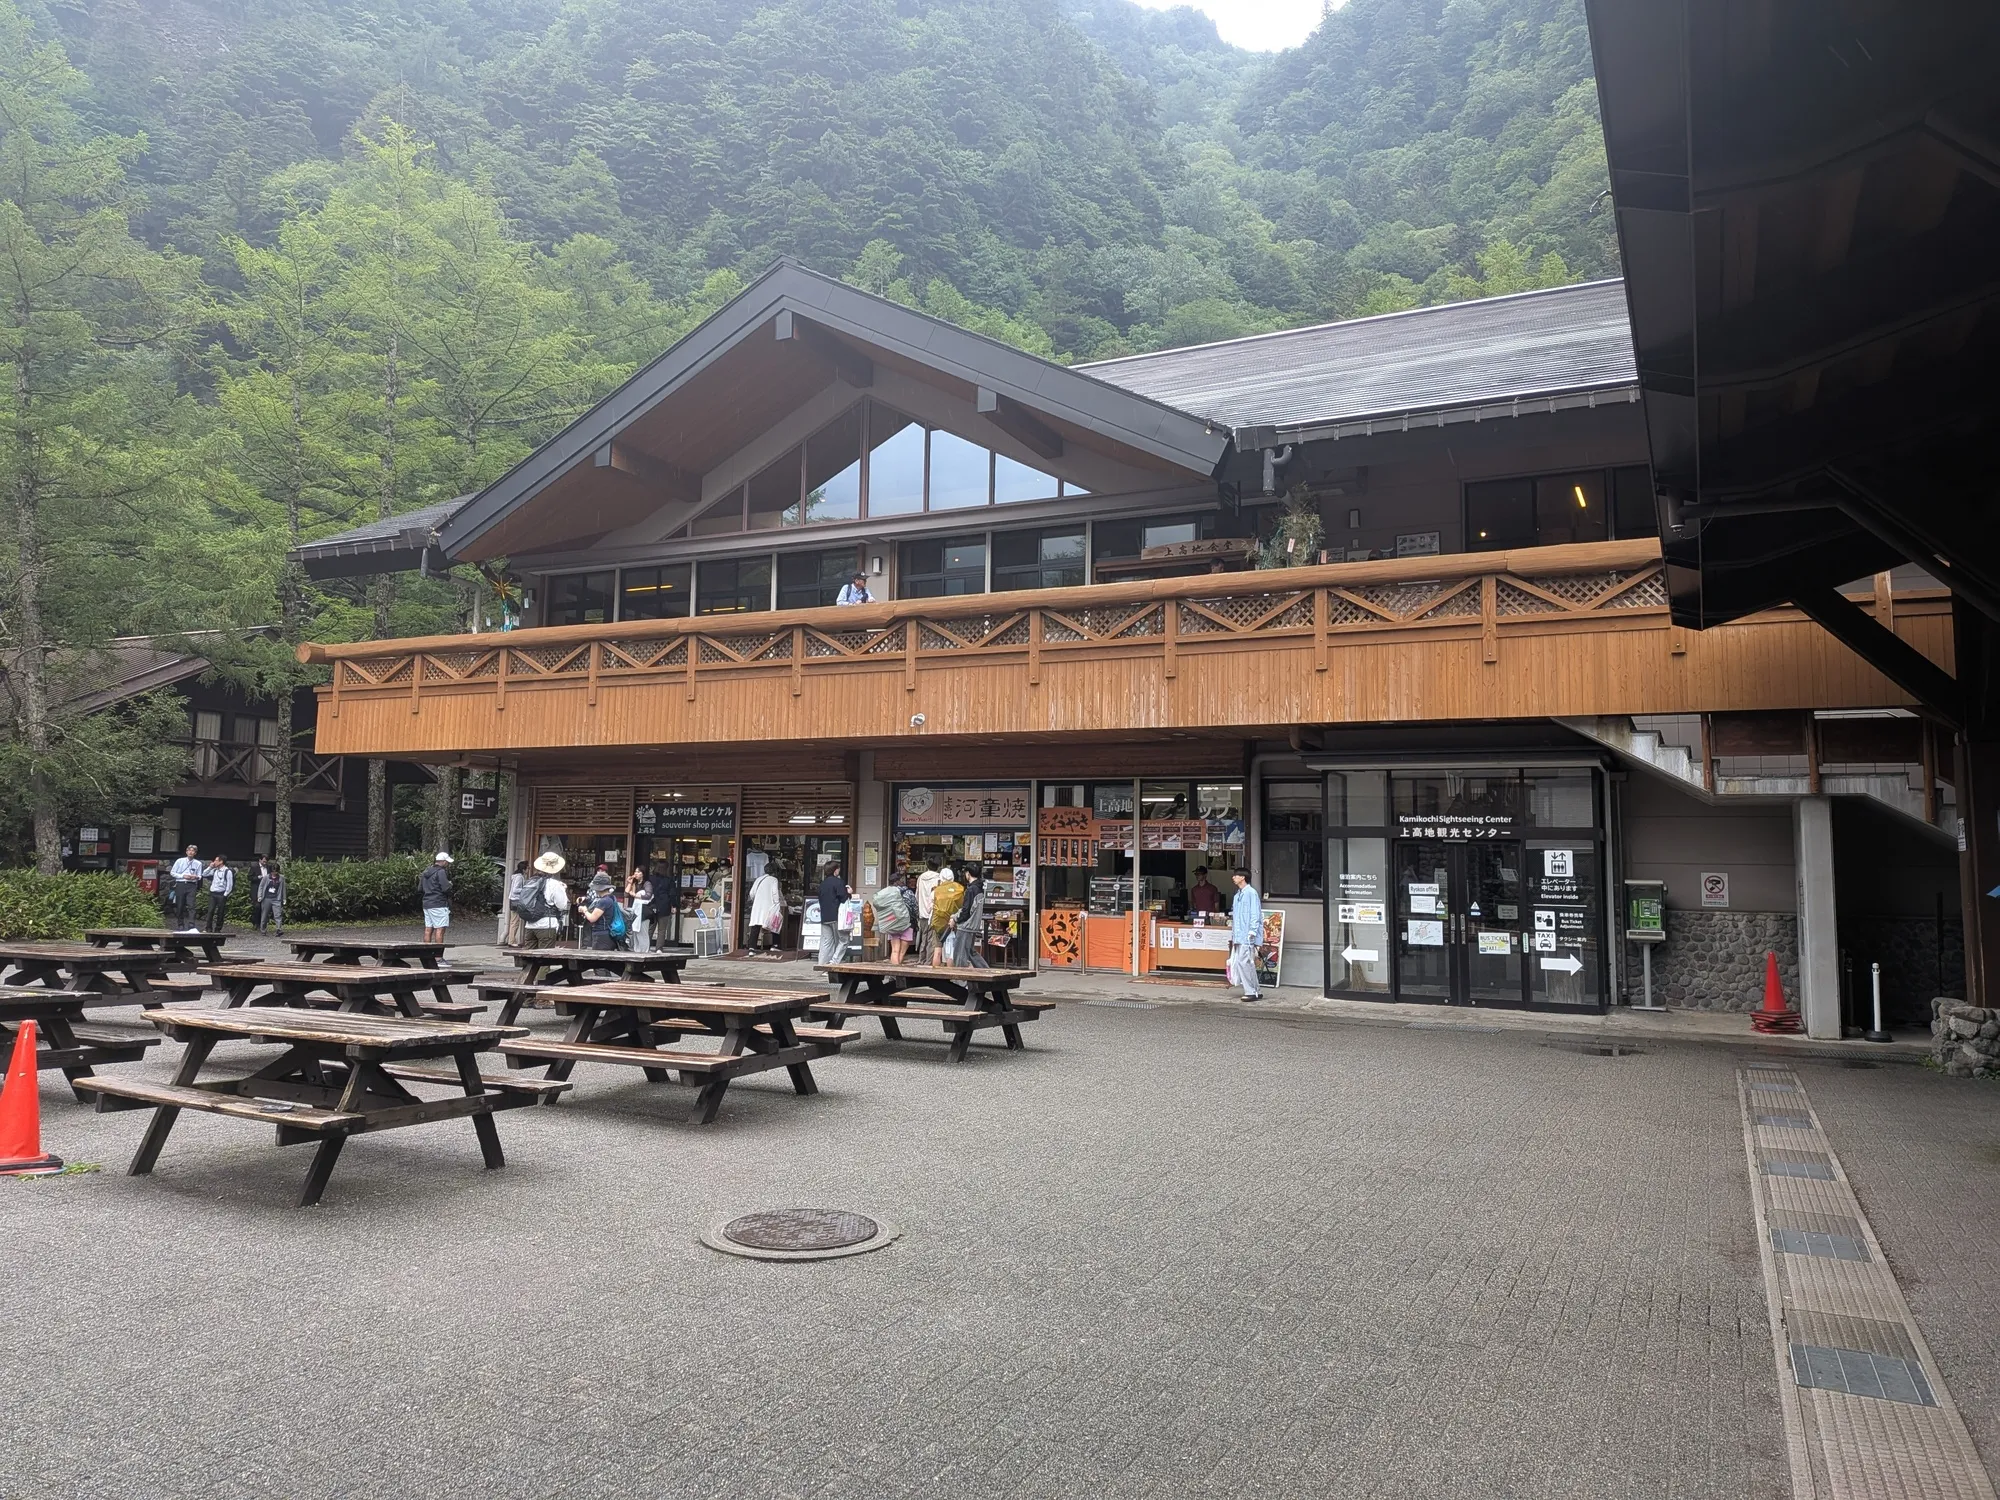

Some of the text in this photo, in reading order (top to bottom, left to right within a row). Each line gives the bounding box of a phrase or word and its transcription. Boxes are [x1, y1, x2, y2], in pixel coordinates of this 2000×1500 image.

[1164, 539, 1234, 556] 上高地会堂
[955, 798, 1026, 818] 河童焼
[1099, 798, 1133, 813] 上高地
[662, 807, 698, 816] おみやげ処
[662, 820, 732, 830] souvenir shop pickel
[1399, 815, 1512, 824] Kamikochi Sightseeing Center
[1400, 827, 1511, 838] 上高地観光センター
